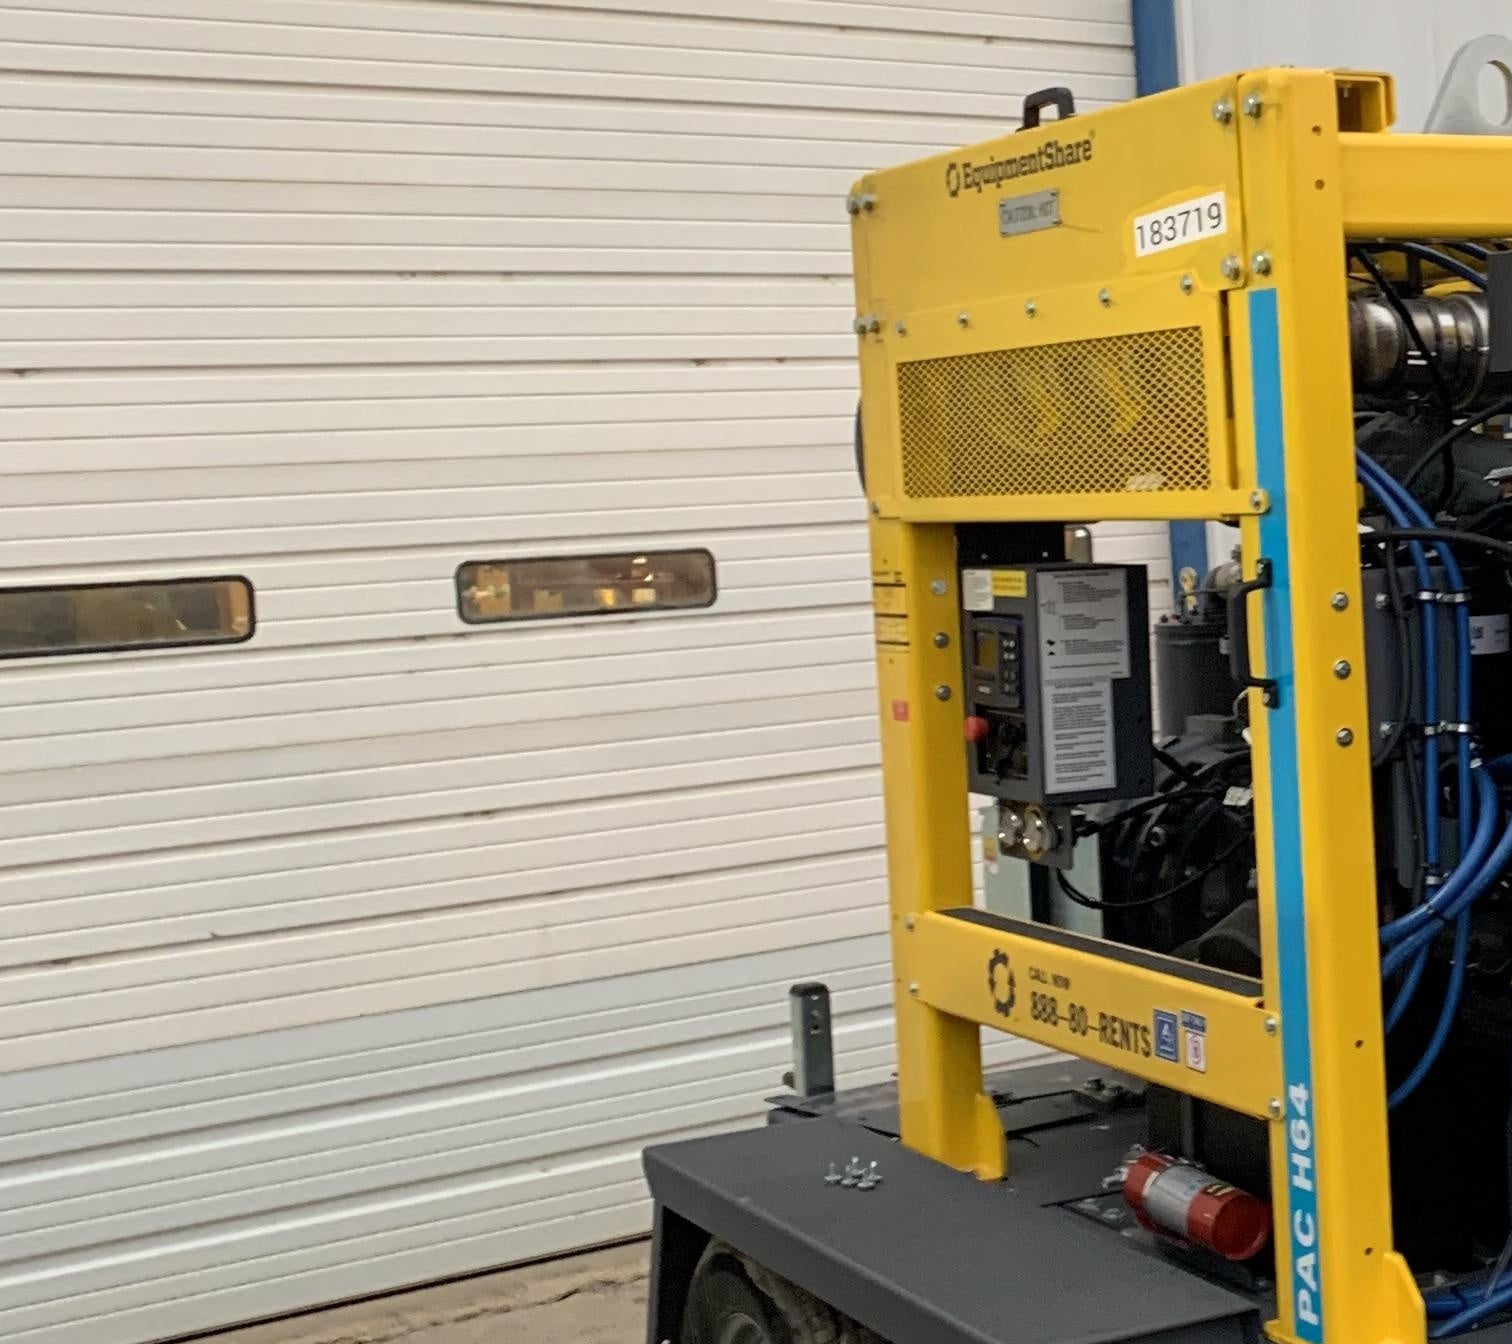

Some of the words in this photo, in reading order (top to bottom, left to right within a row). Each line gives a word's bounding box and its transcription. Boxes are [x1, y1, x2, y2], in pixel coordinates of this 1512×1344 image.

[962, 139, 1092, 192] EquipmentShare
[1136, 202, 1222, 249] 183719
[1288, 1081, 1312, 1192] HG4
[1294, 1208, 1319, 1326] PAC
